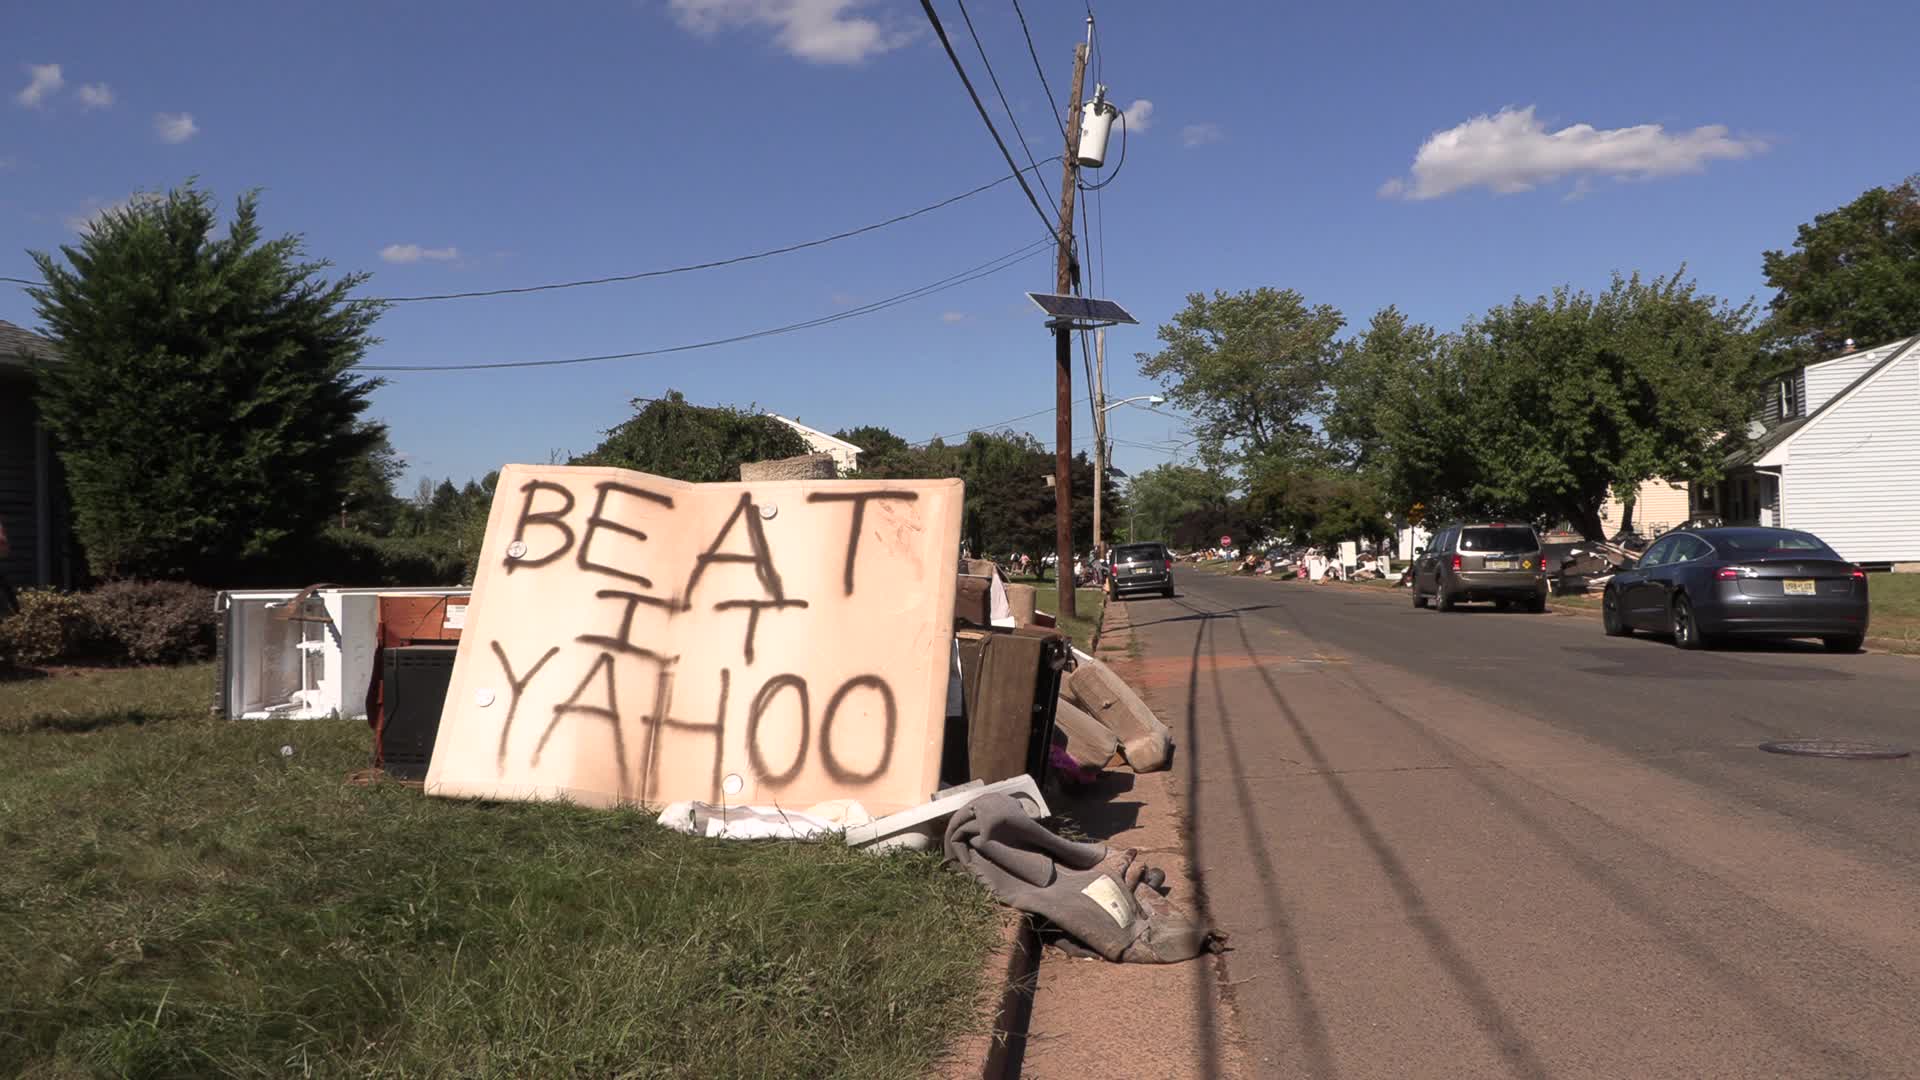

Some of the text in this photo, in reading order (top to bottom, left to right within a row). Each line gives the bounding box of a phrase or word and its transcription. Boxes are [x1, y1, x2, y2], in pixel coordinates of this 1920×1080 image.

[503, 480, 918, 611] BEAT
[576, 589, 809, 666] IT
[491, 639, 897, 801] YAHOO
